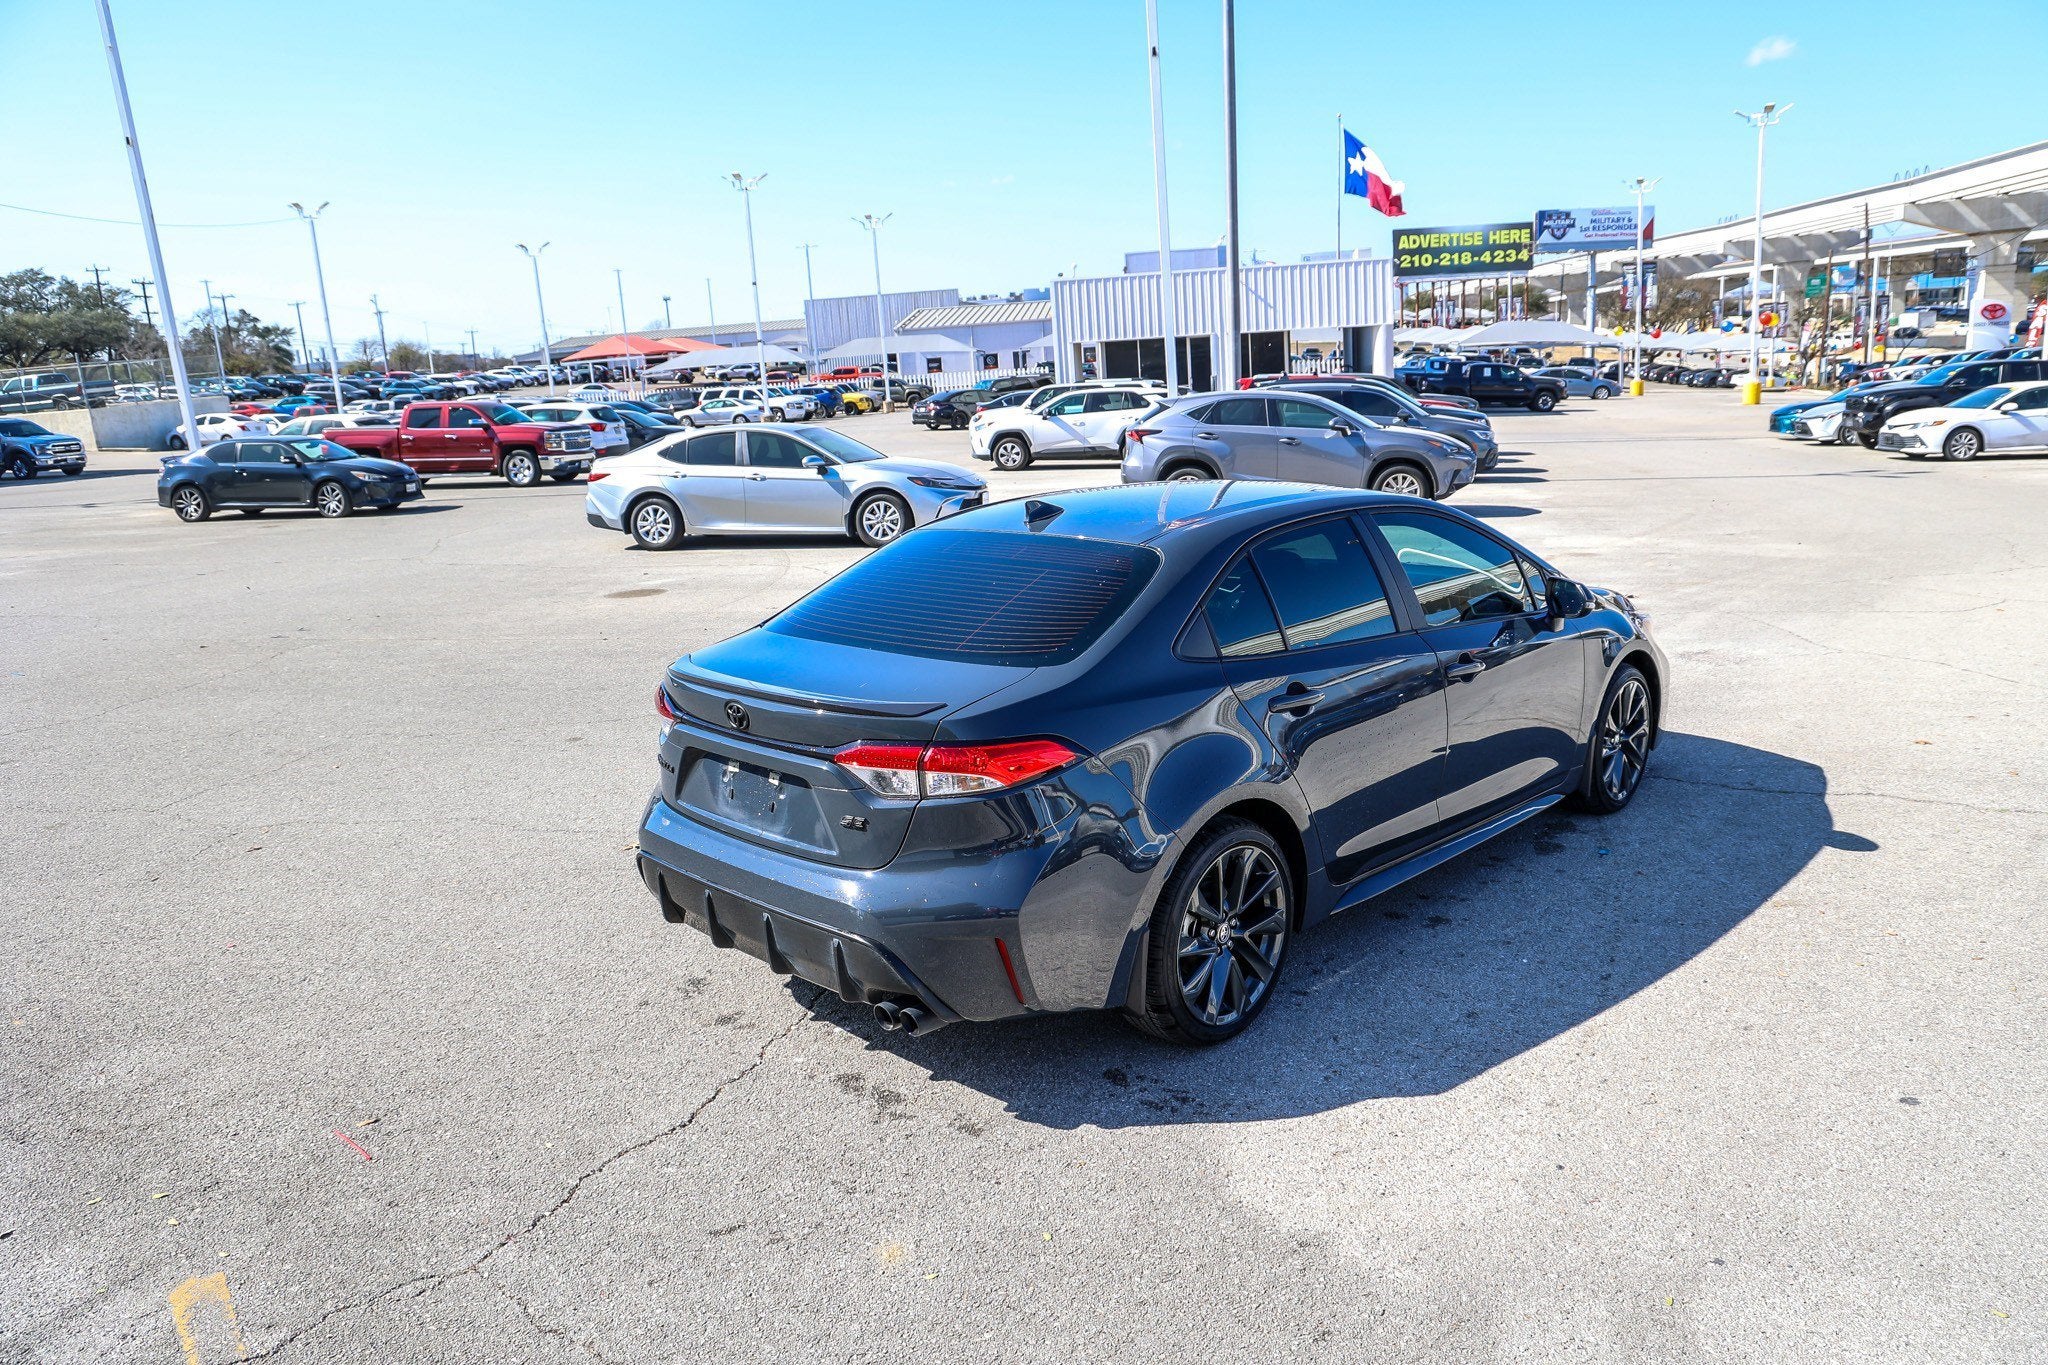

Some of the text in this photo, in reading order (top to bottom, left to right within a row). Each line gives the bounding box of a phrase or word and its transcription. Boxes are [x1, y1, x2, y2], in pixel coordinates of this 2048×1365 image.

[1590, 216, 1626, 224] MILITARY
[1398, 228, 1531, 250] ADVERTISE HERE
[1400, 248, 1530, 268] 210-218-4234
